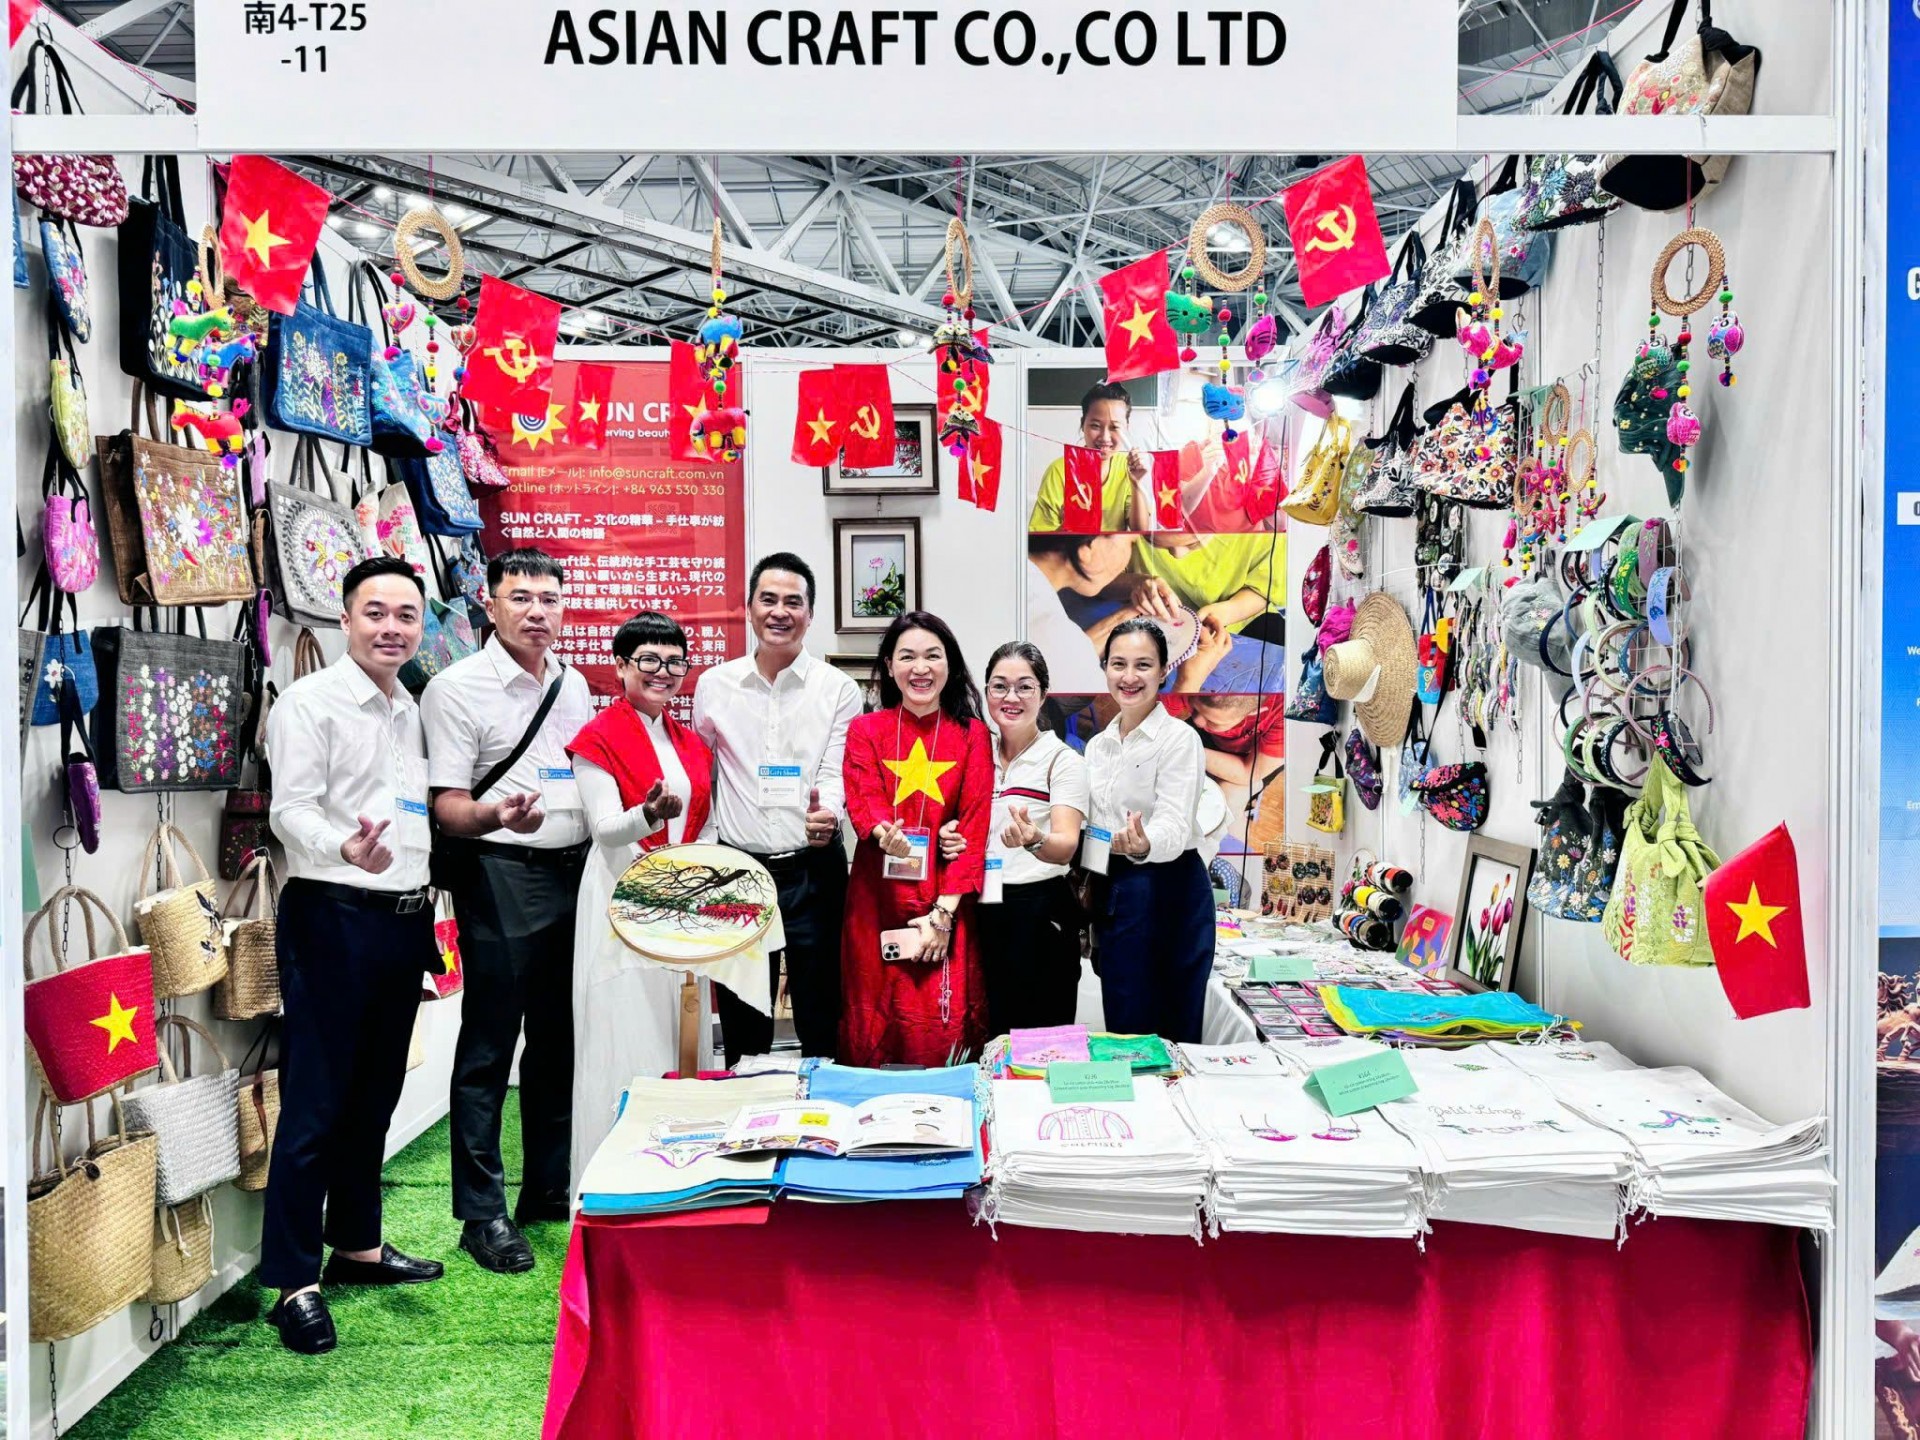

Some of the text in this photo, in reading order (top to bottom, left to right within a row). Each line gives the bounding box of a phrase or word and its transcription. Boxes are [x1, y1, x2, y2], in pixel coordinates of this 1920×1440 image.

[244, 1, 367, 34] 南4-T25
[543, 9, 1287, 75] ASIAN CRAFT CO.,CO LTD
[281, 45, 327, 72] -11
[589, 465, 725, 480] info@suncraft.com.vn
[623, 484, 646, 494] +84
[649, 485, 672, 495] 963
[676, 485, 699, 496] 530
[702, 485, 726, 496] 330
[500, 512, 531, 524] SUN
[533, 513, 582, 525] CRAFT
